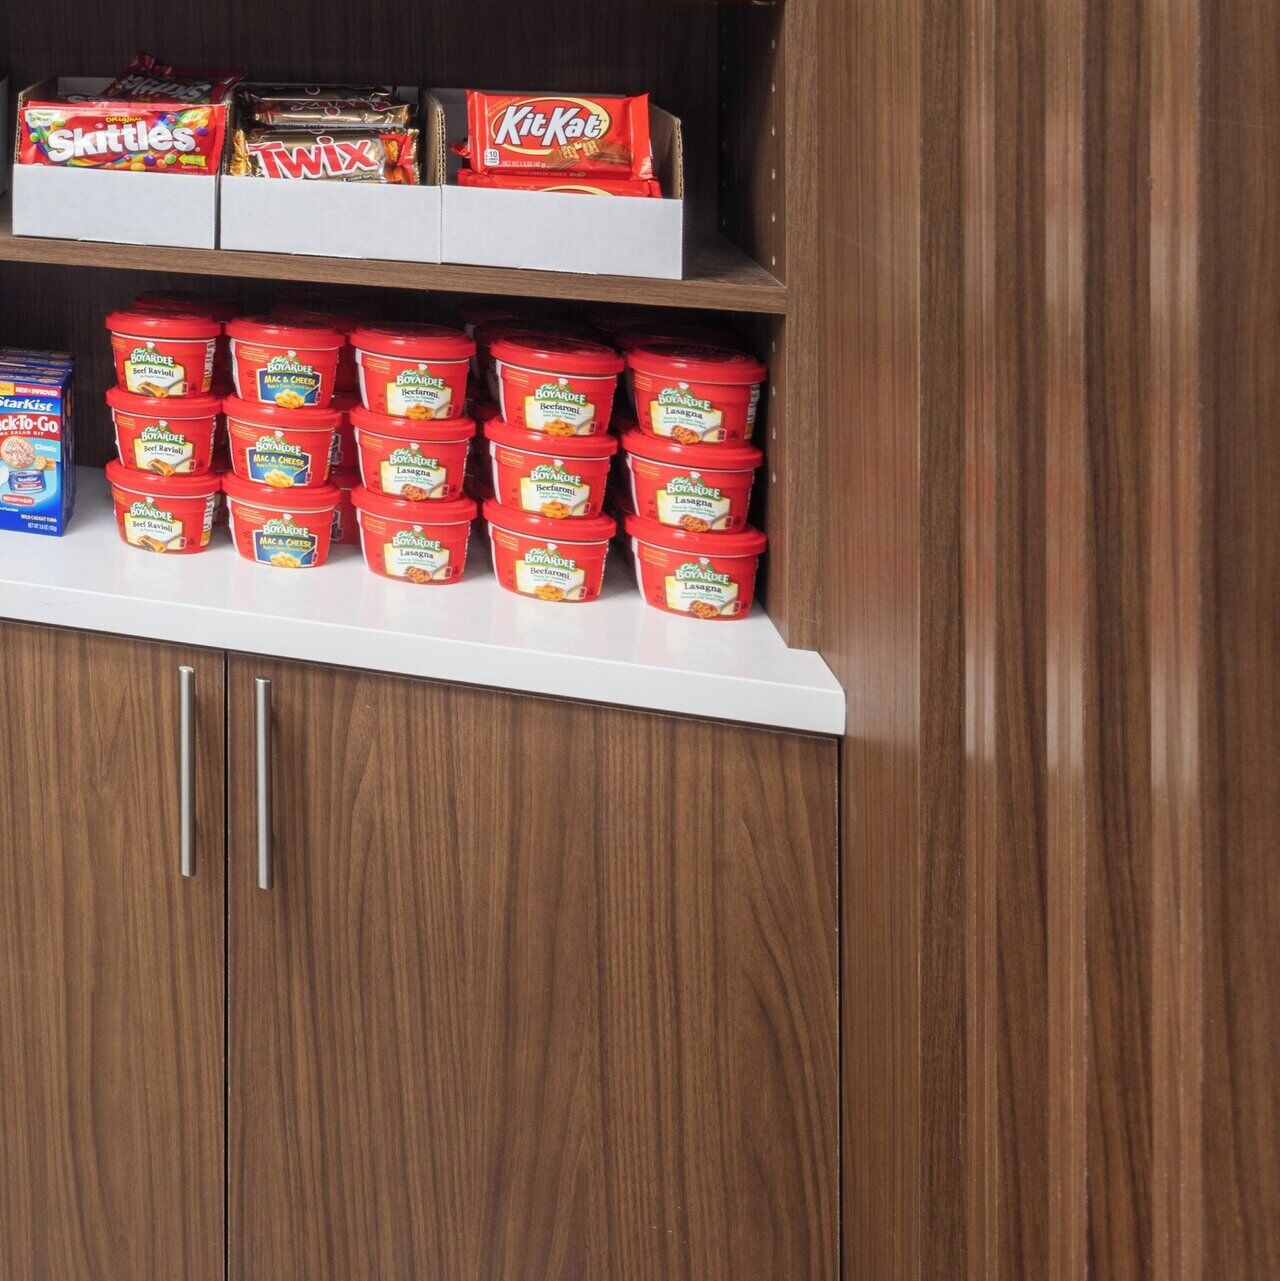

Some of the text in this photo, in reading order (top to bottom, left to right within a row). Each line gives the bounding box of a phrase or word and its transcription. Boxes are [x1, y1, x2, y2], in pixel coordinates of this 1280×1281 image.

[47, 120, 196, 162] Skittles
[130, 353, 174, 366] BOYARDEE
[133, 367, 174, 377] Beef Ravioli
[267, 363, 313, 374] BOYARDEE
[264, 375, 315, 385] MAC & CHEESE
[396, 374, 444, 389] BOYARDEE
[536, 389, 586, 404] BOYARDEE
[658, 394, 711, 410] BOYARDEE
[540, 403, 580, 415] Beefaroni
[256, 443, 301, 454] BOYARDEE
[389, 454, 438, 469] BOYARDEE
[667, 484, 720, 498] BOYARDEE
[674, 496, 712, 508] Lasagna
[525, 554, 575, 569] BOYARDEE
